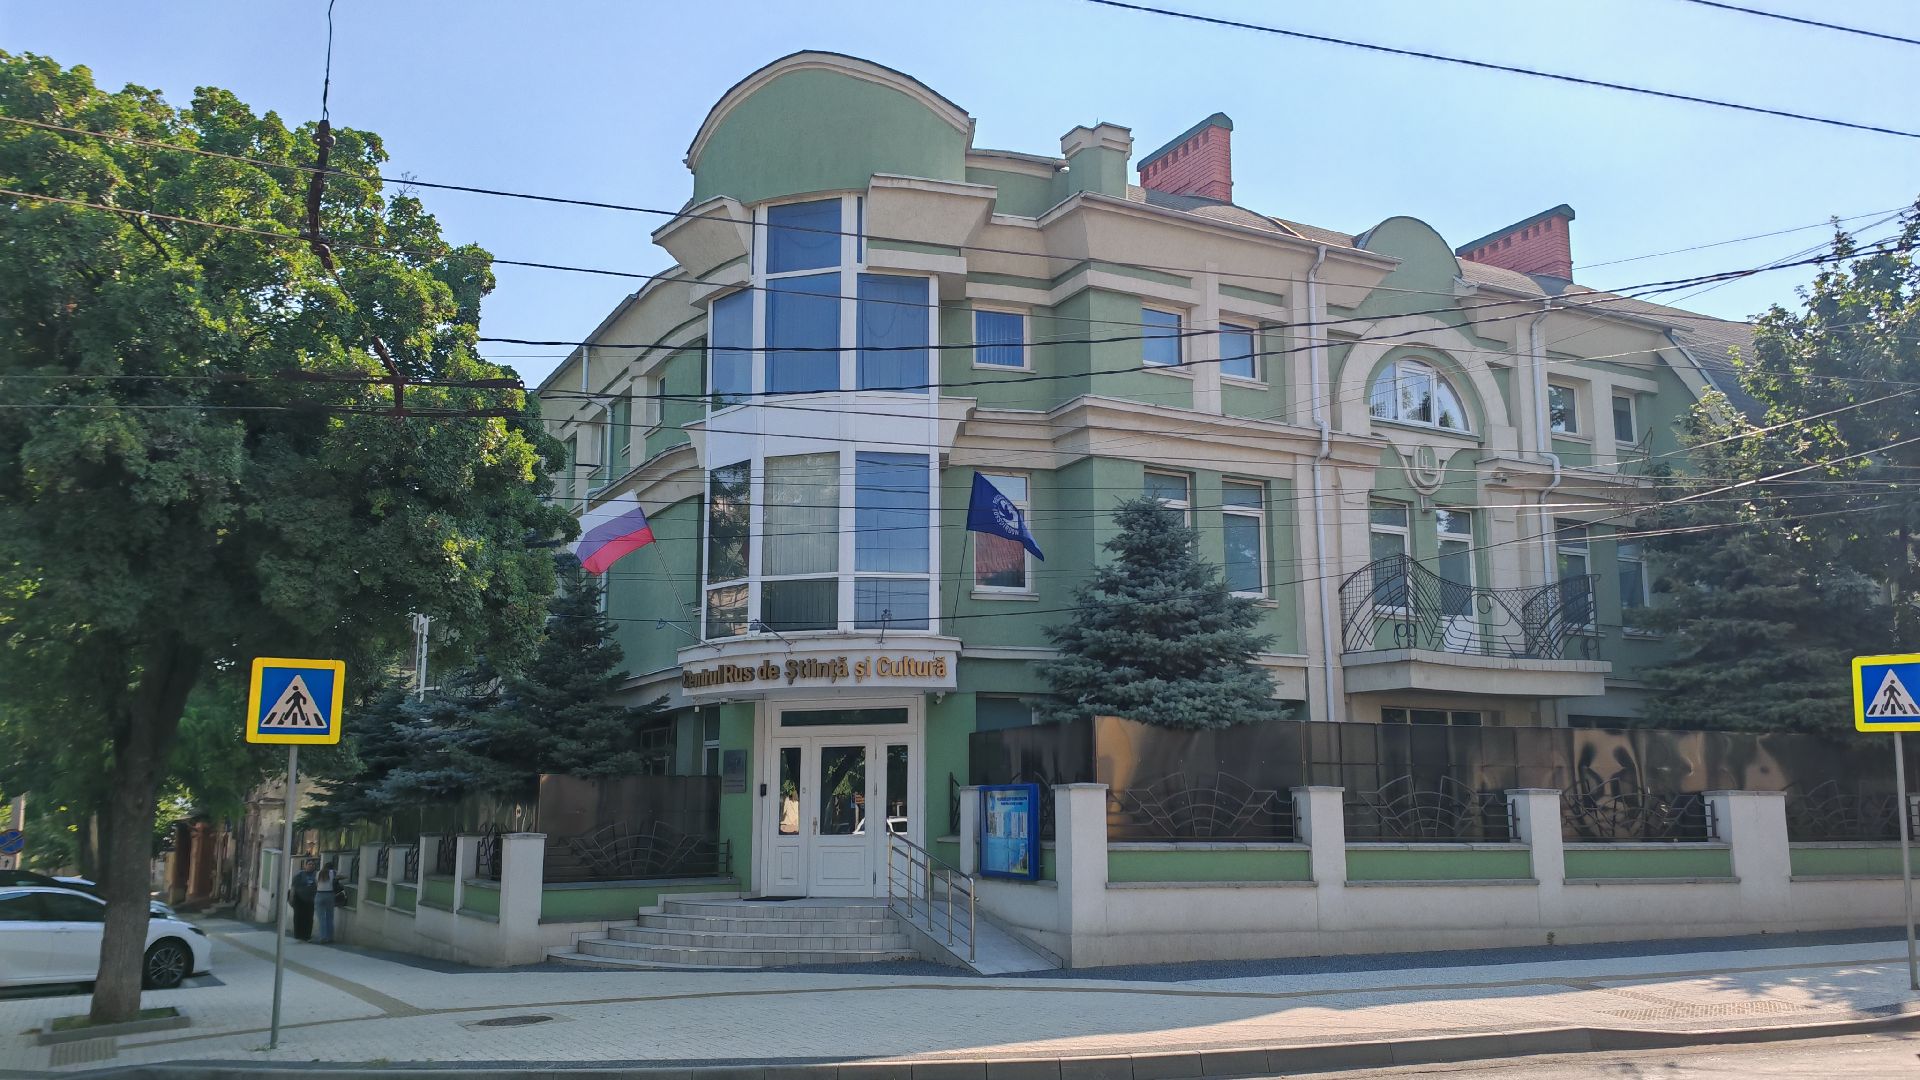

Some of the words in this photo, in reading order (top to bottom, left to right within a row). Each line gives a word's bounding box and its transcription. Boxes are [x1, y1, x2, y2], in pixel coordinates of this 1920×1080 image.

[724, 664, 755, 683] Rus
[757, 659, 780, 680] de
[876, 655, 947, 678] Cultură
